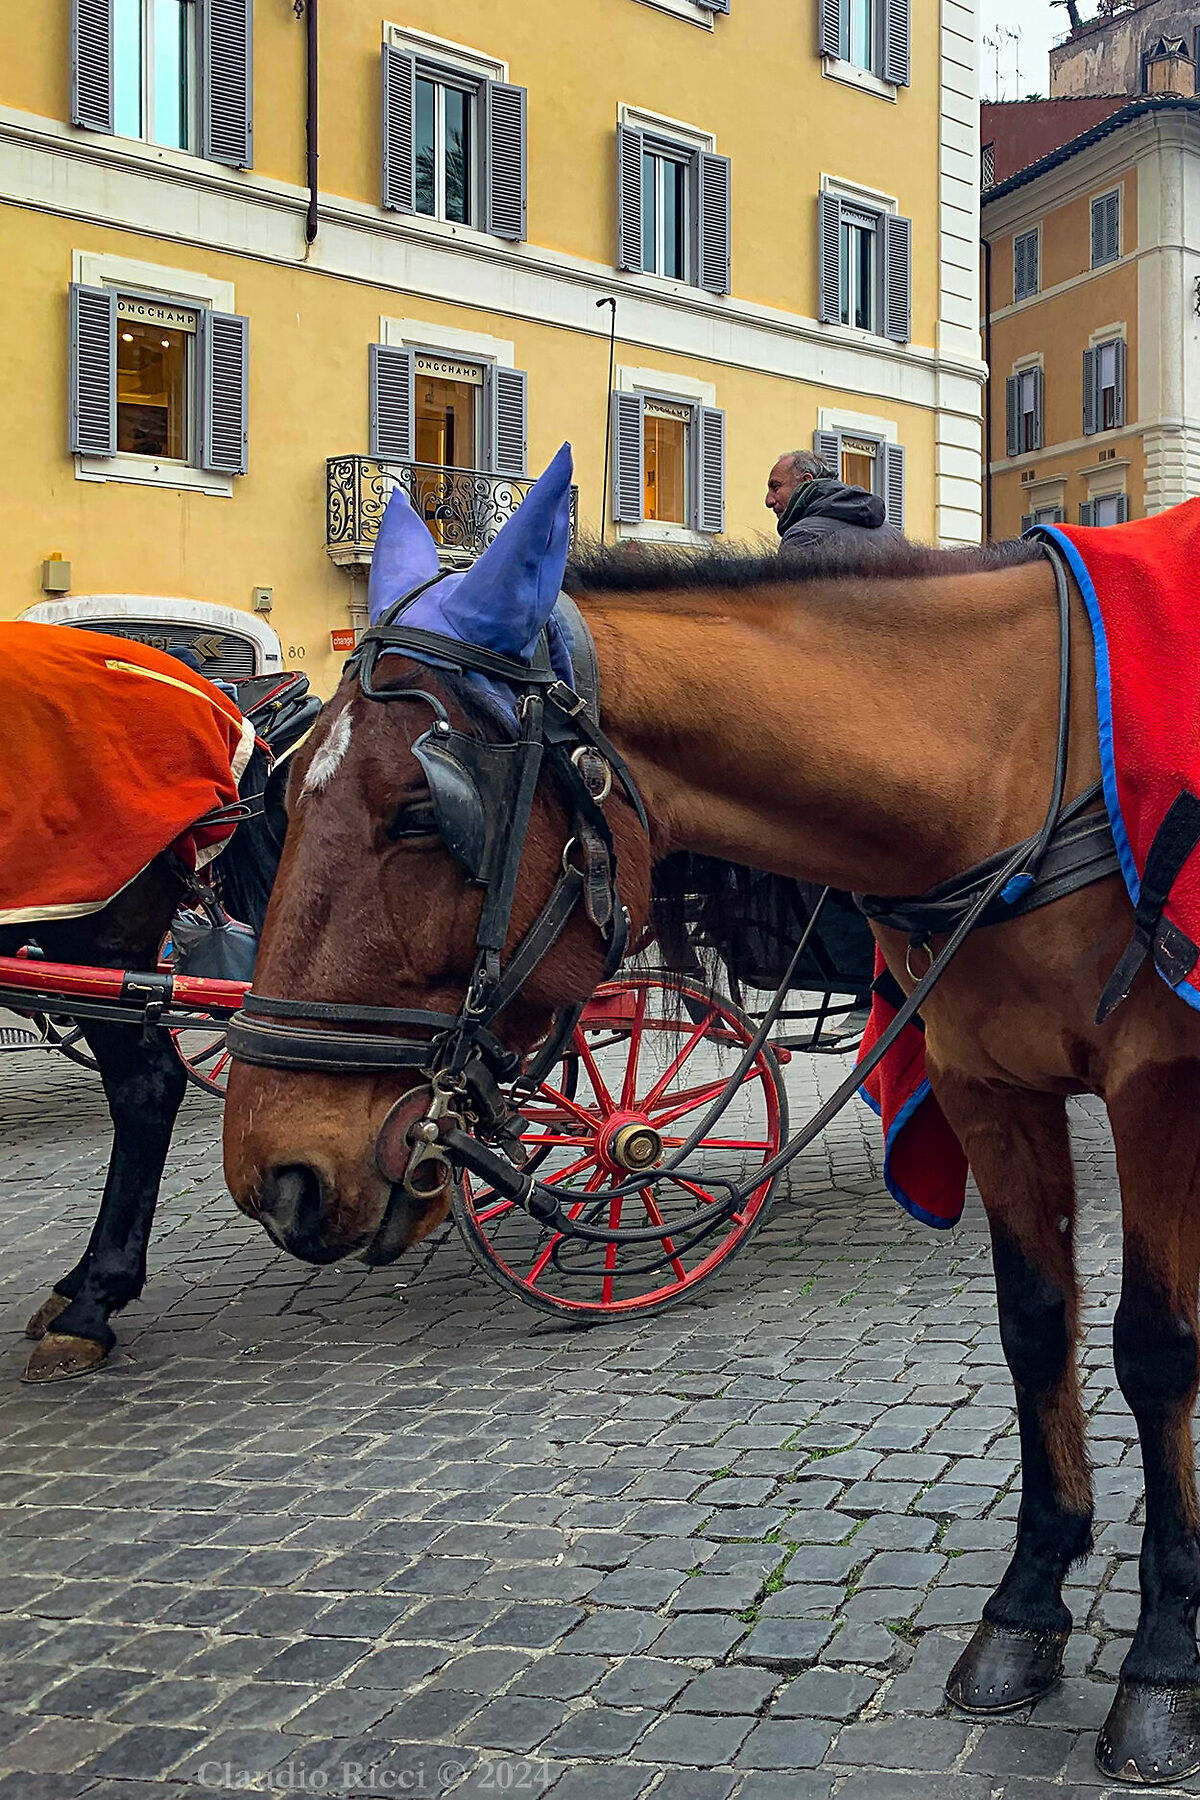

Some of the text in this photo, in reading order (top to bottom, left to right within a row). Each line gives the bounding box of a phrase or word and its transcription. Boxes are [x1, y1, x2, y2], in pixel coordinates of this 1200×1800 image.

[117, 301, 195, 324] ONGCHAMP
[414, 360, 478, 377] ONGCHAMP
[333, 636, 354, 647] change
[288, 645, 306, 660] 80
